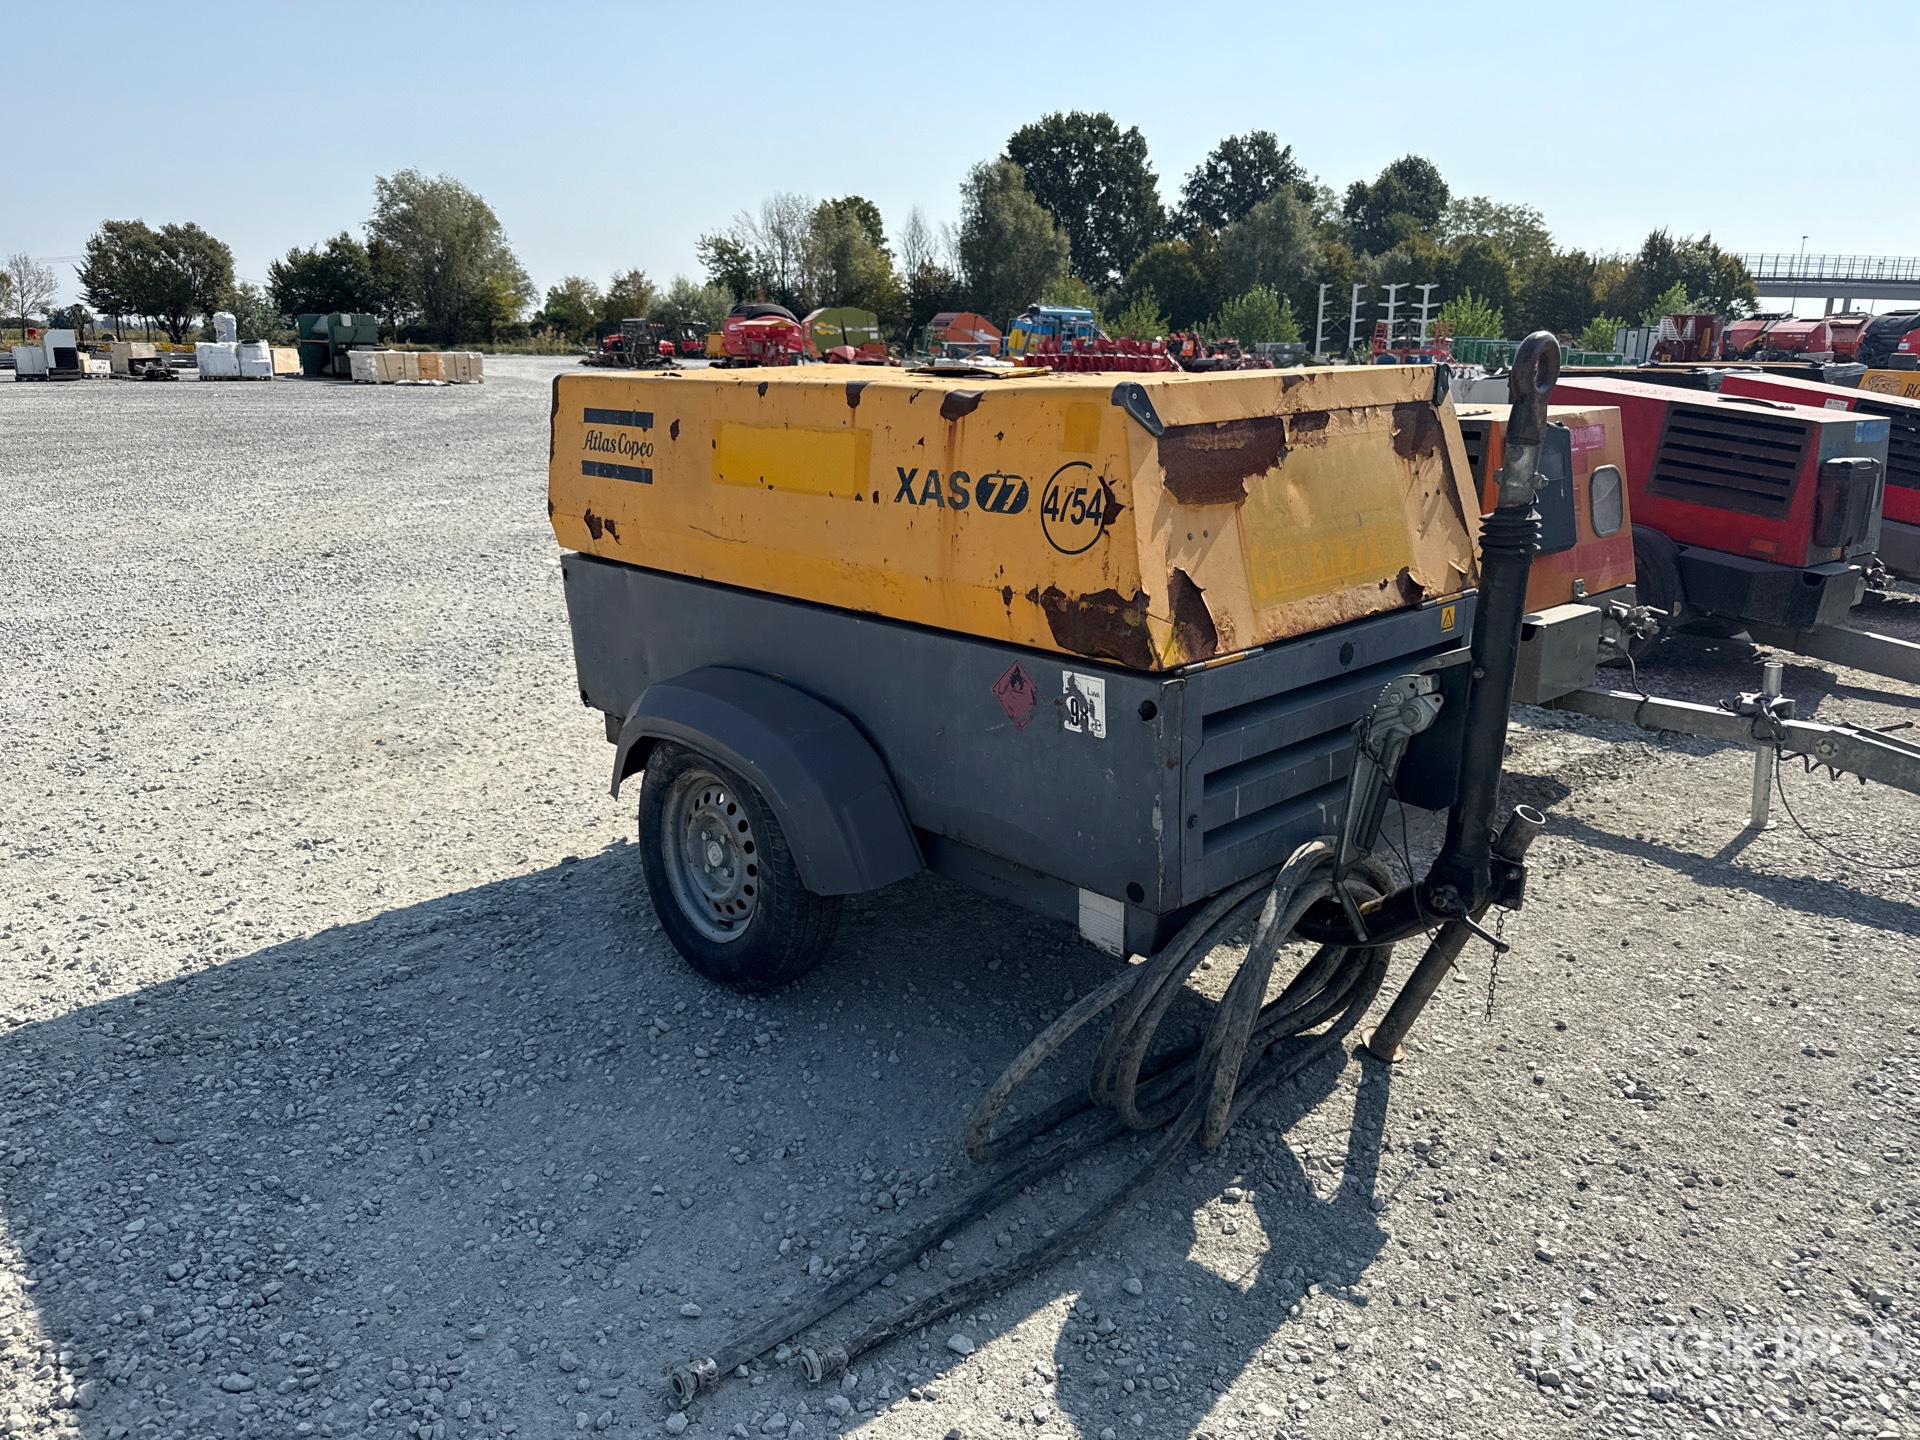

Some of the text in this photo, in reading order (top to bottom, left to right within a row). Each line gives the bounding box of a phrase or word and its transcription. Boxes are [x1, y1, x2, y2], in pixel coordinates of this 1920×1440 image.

[582, 430, 653, 460] Atlas Copco
[893, 466, 1024, 512] XAS 77
[1043, 484, 1103, 527] 4/54
